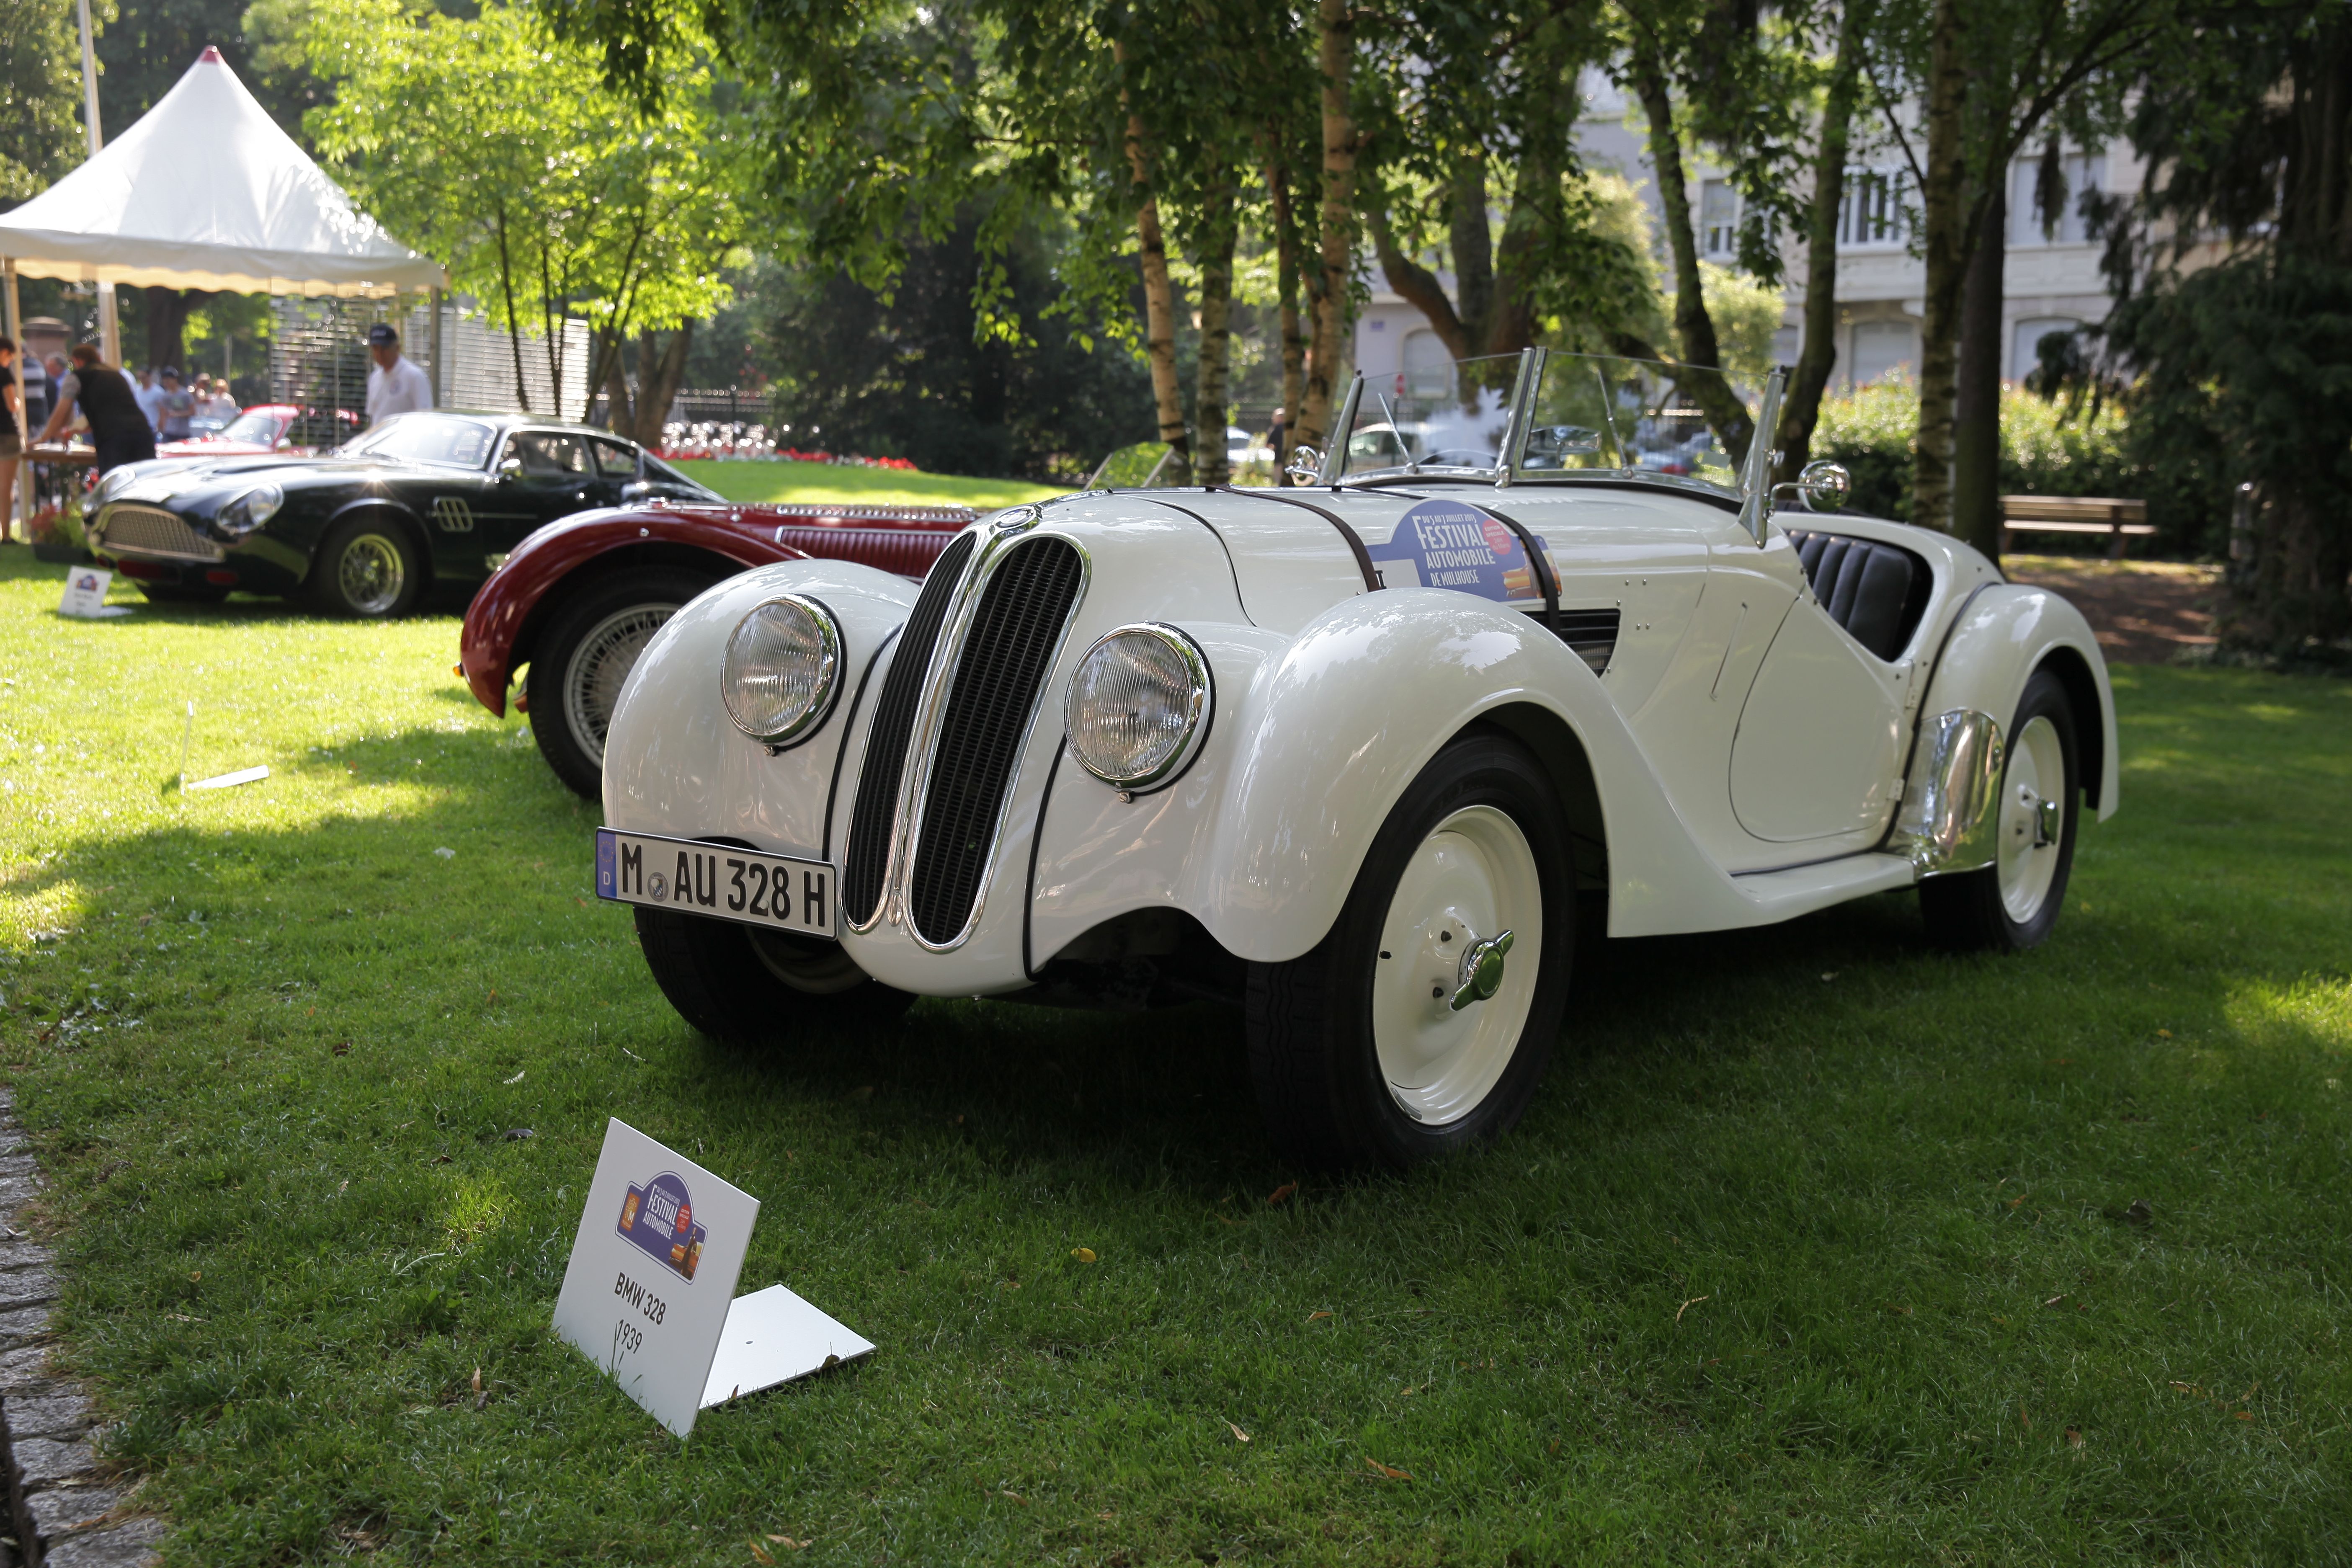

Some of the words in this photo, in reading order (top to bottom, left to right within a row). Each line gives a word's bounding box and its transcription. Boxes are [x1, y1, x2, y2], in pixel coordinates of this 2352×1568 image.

[1412, 516, 1489, 549] FESTIVAL
[1429, 515, 1435, 525] 5
[1445, 514, 1464, 523] JUILLET
[1463, 513, 1477, 524] 2013
[1425, 548, 1496, 569] AUTOMOBILE
[1430, 572, 1442, 587] DE
[1440, 570, 1480, 586] MULHOUSE
[603, 871, 610, 885] D
[622, 842, 642, 895] M
[674, 851, 716, 907] AU
[727, 858, 791, 920] 328
[804, 871, 825, 927] H
[647, 1184, 678, 1225] FESTIVAL
[642, 1210, 673, 1240] AUTOMOBILE
[614, 1271, 646, 1309] BMW
[644, 1293, 666, 1325] 328
[617, 1319, 642, 1354] 1939
